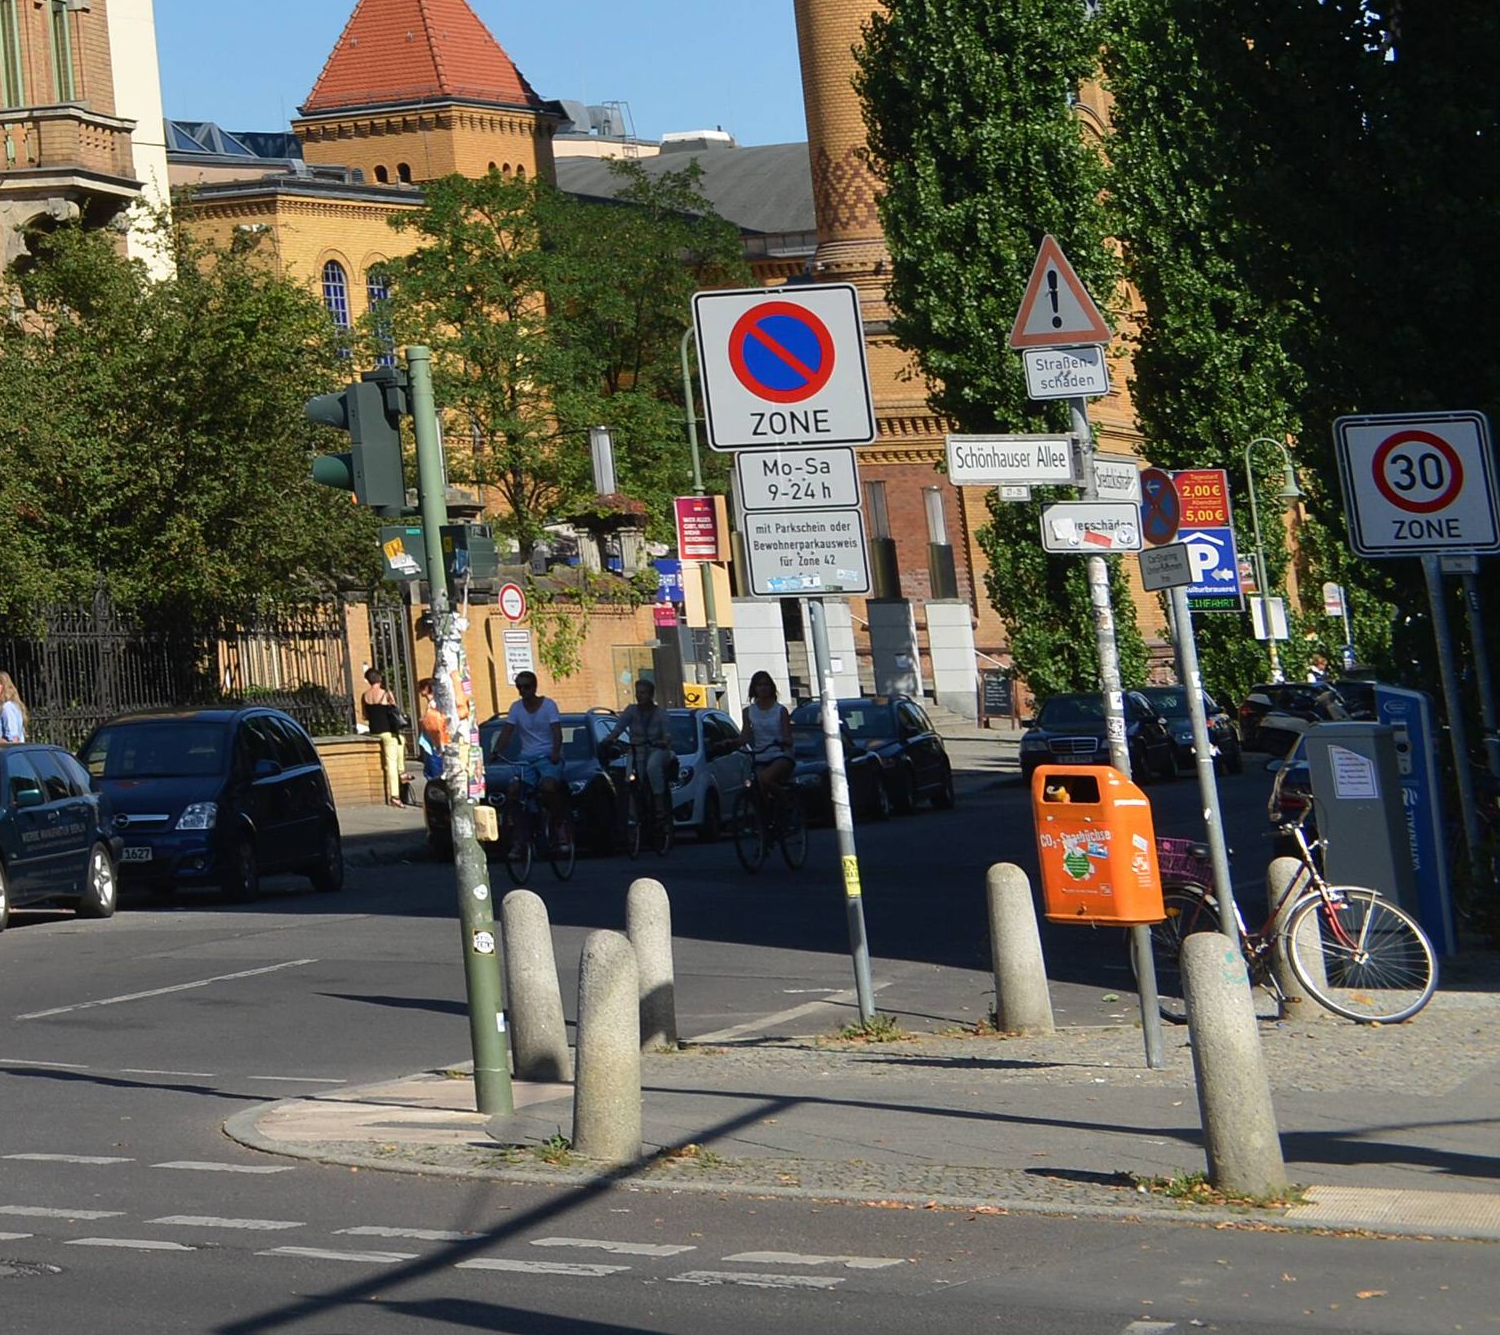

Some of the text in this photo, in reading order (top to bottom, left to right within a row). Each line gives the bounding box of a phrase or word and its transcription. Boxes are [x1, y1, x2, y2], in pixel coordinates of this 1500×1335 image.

[1035, 357, 1094, 372] Straßen-
[1040, 374, 1095, 390] schäden
[750, 409, 832, 436] ZONE
[955, 445, 1067, 470] Schönhauser Allee
[762, 457, 831, 477] Mo-Sa
[1389, 452, 1445, 492] 30
[768, 481, 832, 501] 9-24 h
[1182, 484, 1222, 497] 2,00 €
[1186, 509, 1225, 522] 5,00 €
[755, 521, 851, 535] mit Parkschein oder
[1391, 518, 1463, 540] ZONE
[753, 538, 858, 553] Bewohnerparkausweis
[779, 554, 837, 567] für Zone 42
[1186, 543, 1220, 583] P
[1187, 598, 1235, 609] EINFAHRT
[1406, 809, 1421, 871] VATTENFALL
[124, 848, 151, 860] 1627
